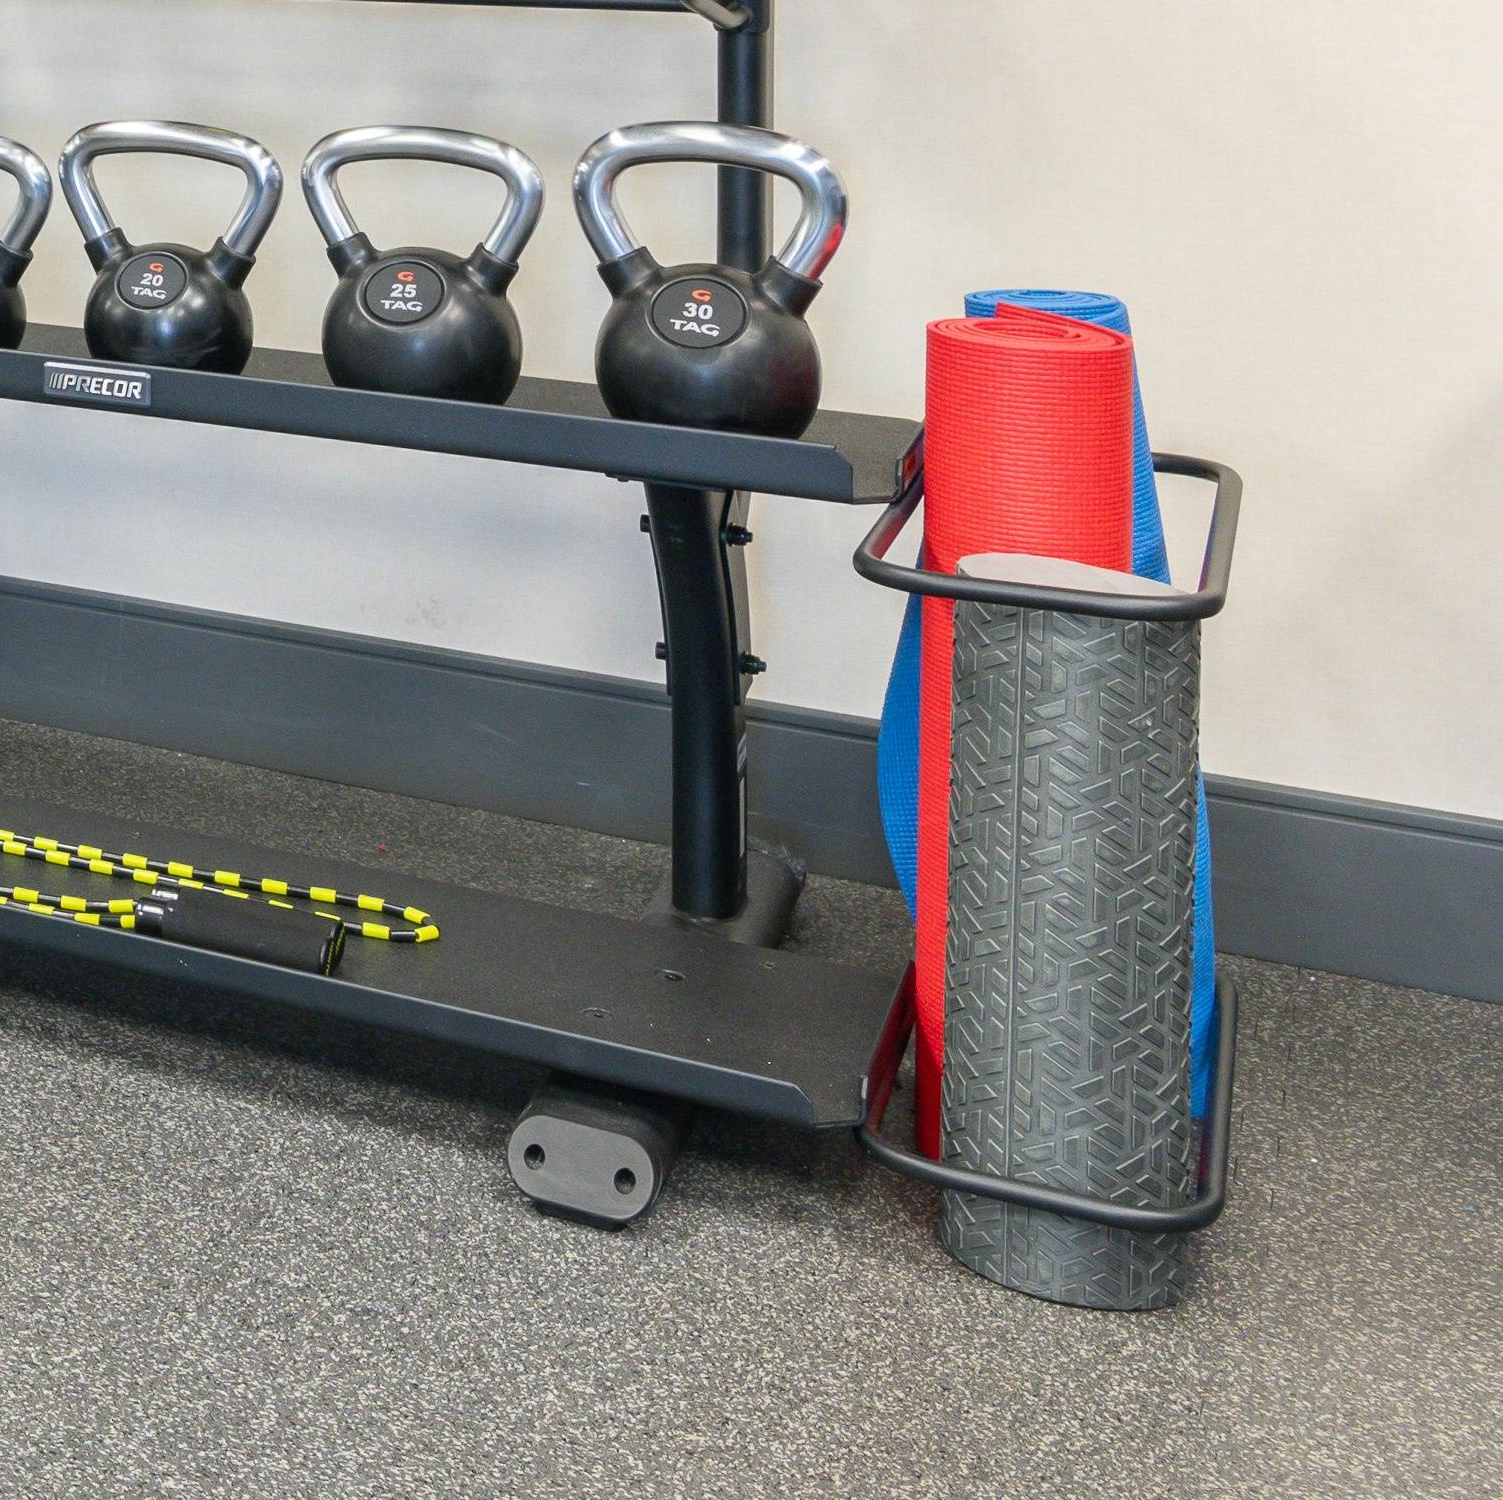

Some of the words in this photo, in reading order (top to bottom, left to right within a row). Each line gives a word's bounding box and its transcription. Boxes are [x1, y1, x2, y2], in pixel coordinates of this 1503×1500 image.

[140, 272, 164, 287] 20
[130, 286, 167, 300] TAG
[390, 283, 417, 298] 25
[380, 299, 424, 312] TAG
[682, 302, 713, 320] 30
[669, 318, 721, 337] TAG
[61, 373, 143, 400] PRECOR
